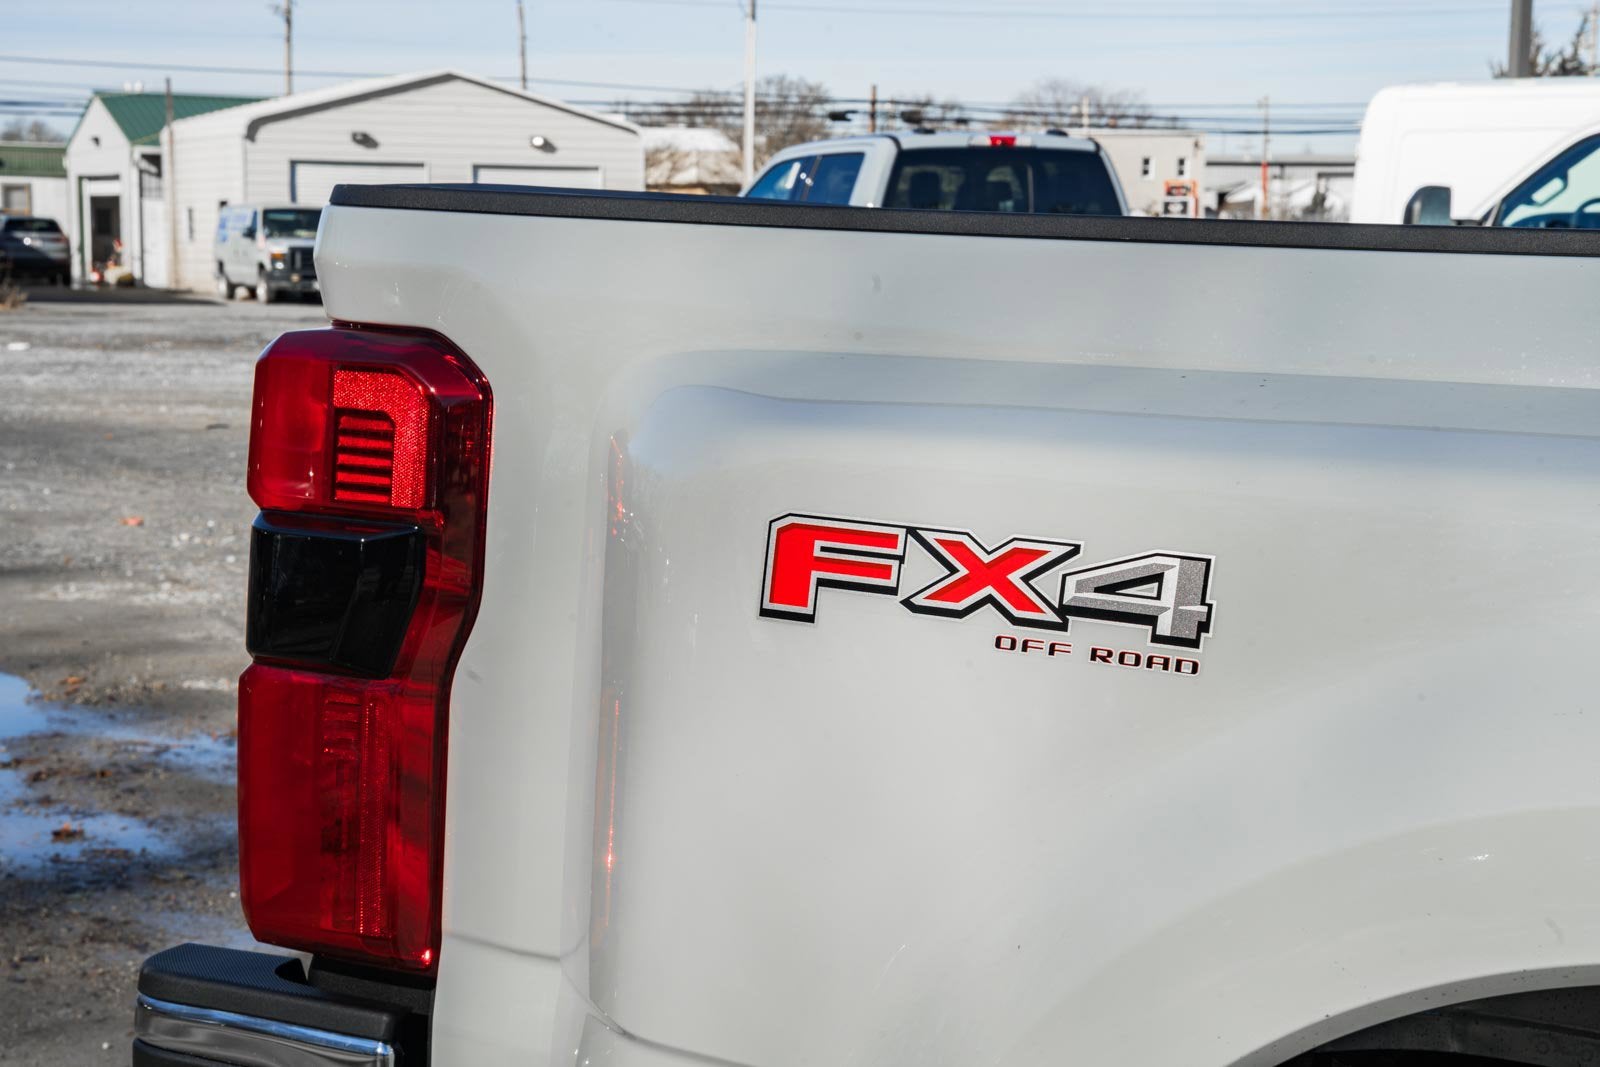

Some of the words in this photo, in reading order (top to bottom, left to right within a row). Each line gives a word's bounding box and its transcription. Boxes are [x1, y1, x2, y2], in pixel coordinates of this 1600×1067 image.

[759, 513, 1213, 648] FX4
[995, 635, 1072, 656] OFF
[1090, 647, 1199, 675] ROAD
